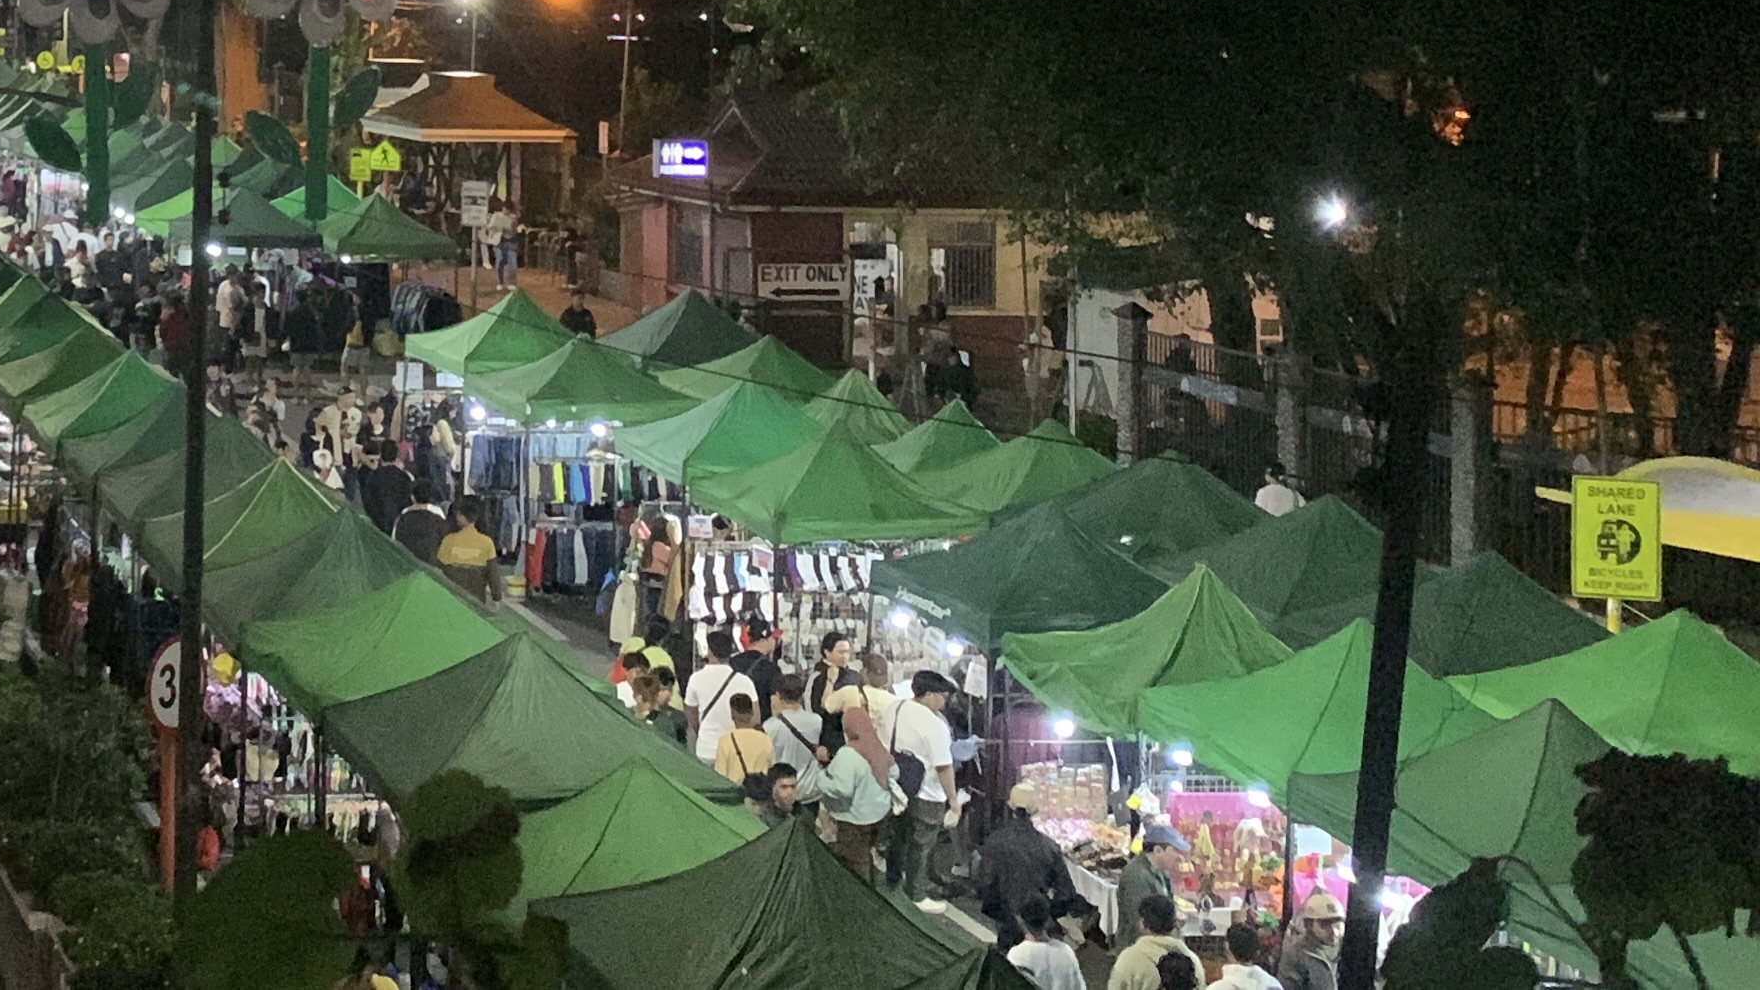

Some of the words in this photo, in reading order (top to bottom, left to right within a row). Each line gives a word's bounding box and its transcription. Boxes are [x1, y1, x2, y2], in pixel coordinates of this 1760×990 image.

[761, 265, 801, 282] EXIT
[806, 265, 847, 282] ONLY
[1587, 486, 1646, 500] SHARED
[1597, 503, 1636, 516] LANE
[1588, 567, 1644, 579] BICYCLES
[158, 663, 177, 709] 3
